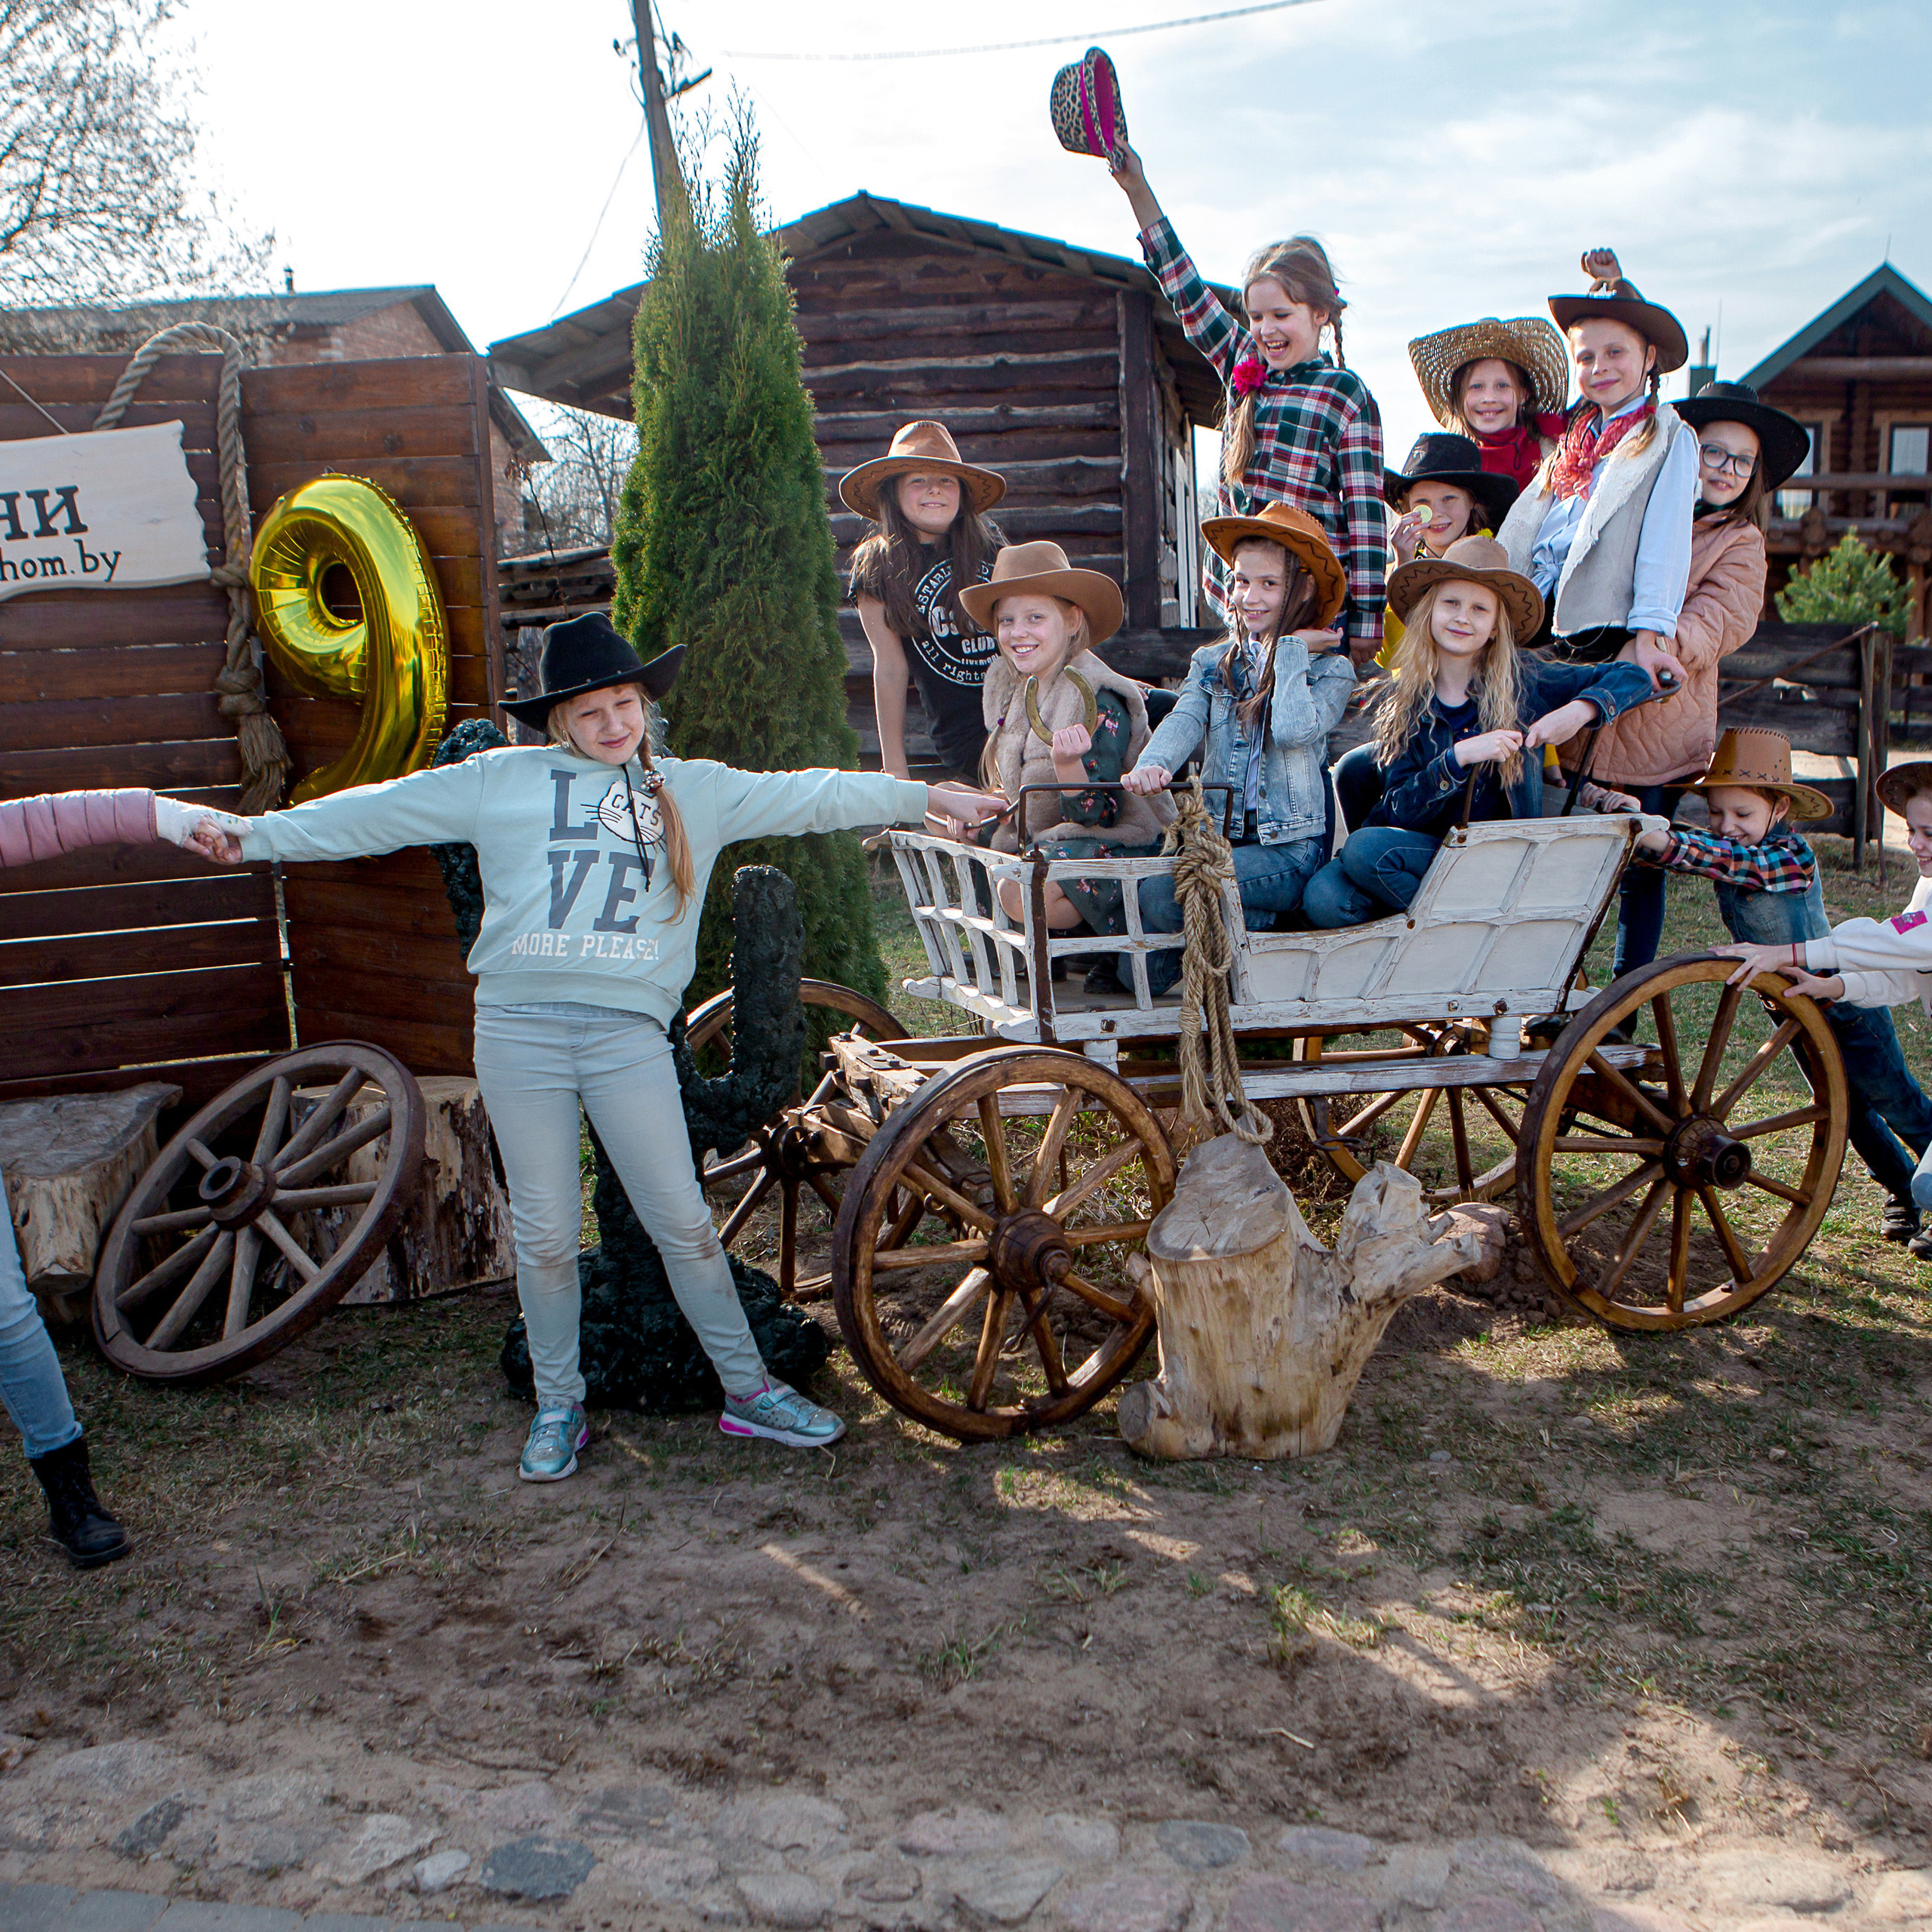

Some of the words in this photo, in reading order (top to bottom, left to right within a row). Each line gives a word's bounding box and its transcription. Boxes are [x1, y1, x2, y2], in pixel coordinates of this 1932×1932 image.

[961, 636, 995, 654] CLUB
[921, 641, 940, 662] all
[943, 663, 986, 682] rights
[511, 933, 571, 957] MORE
